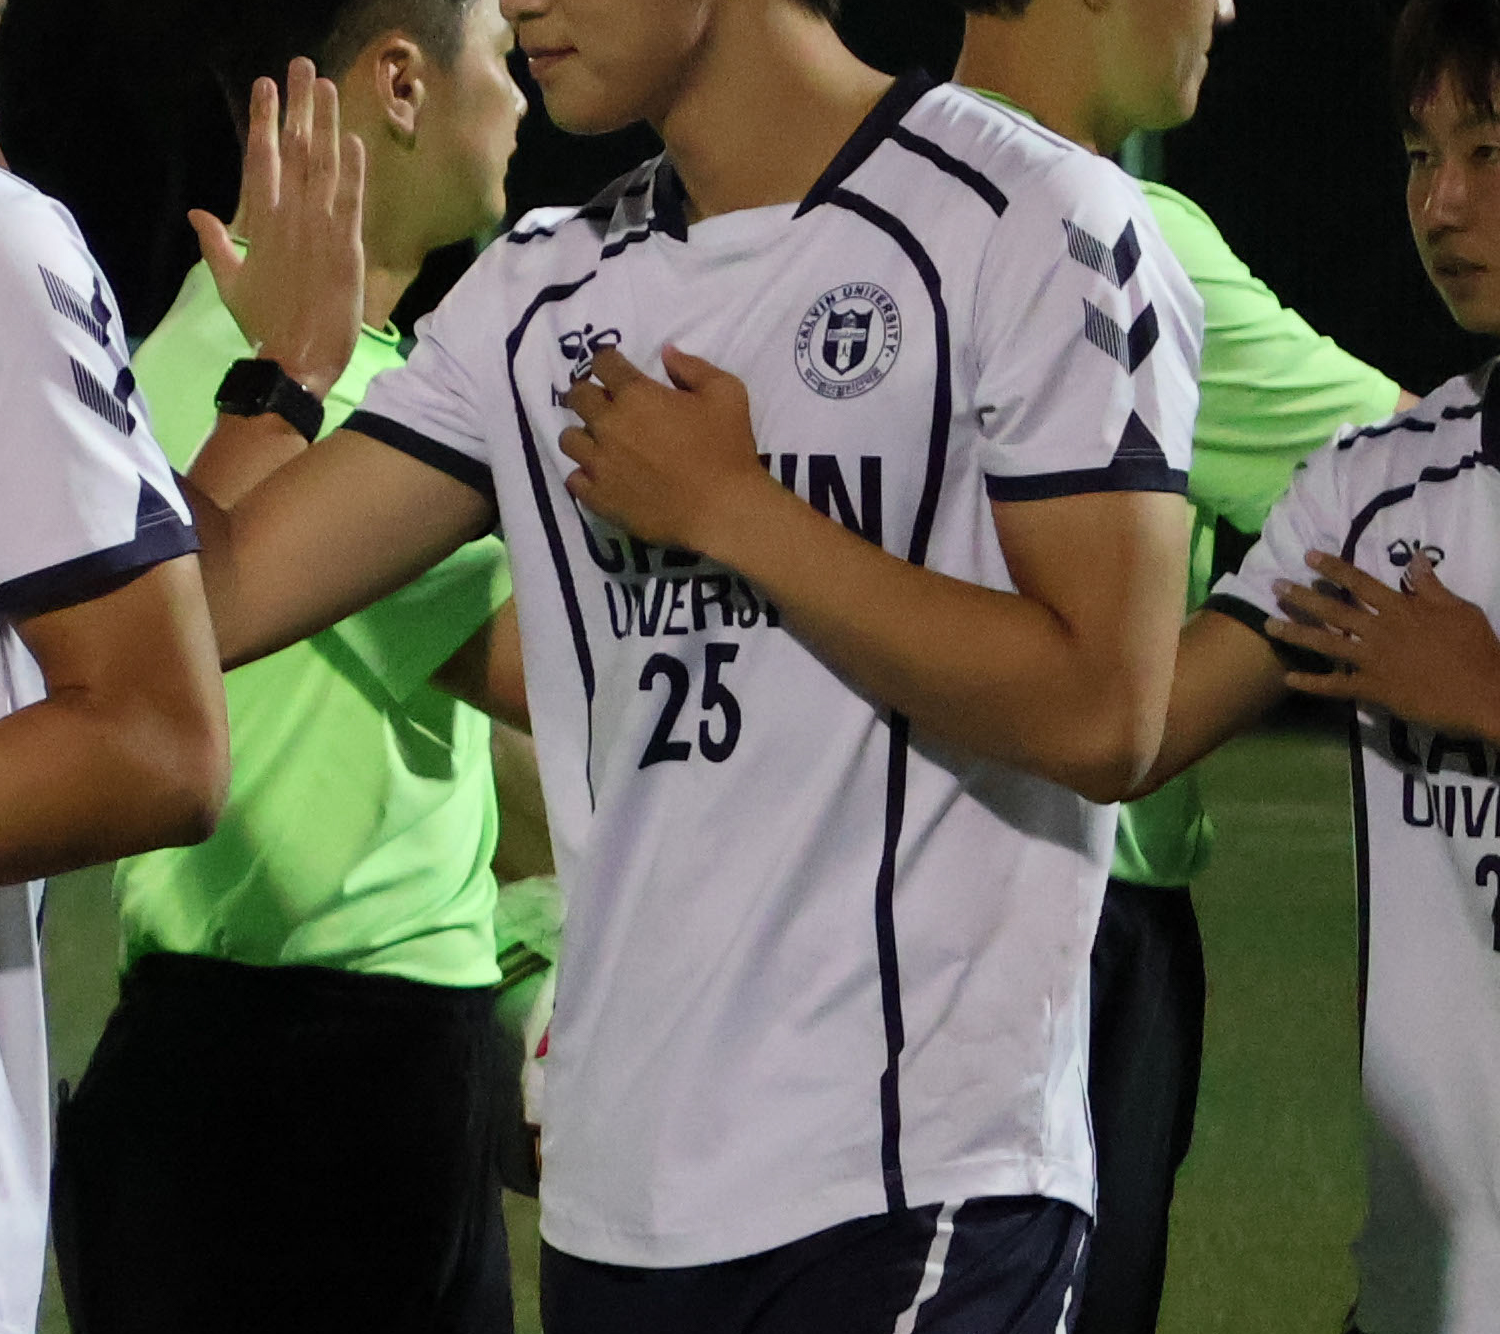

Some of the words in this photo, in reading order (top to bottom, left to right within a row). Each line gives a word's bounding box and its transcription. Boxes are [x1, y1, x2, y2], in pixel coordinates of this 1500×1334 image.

[798, 293, 836, 350] CALVIN
[843, 285, 899, 354] UNIVERSITY
[638, 642, 742, 769] 25
